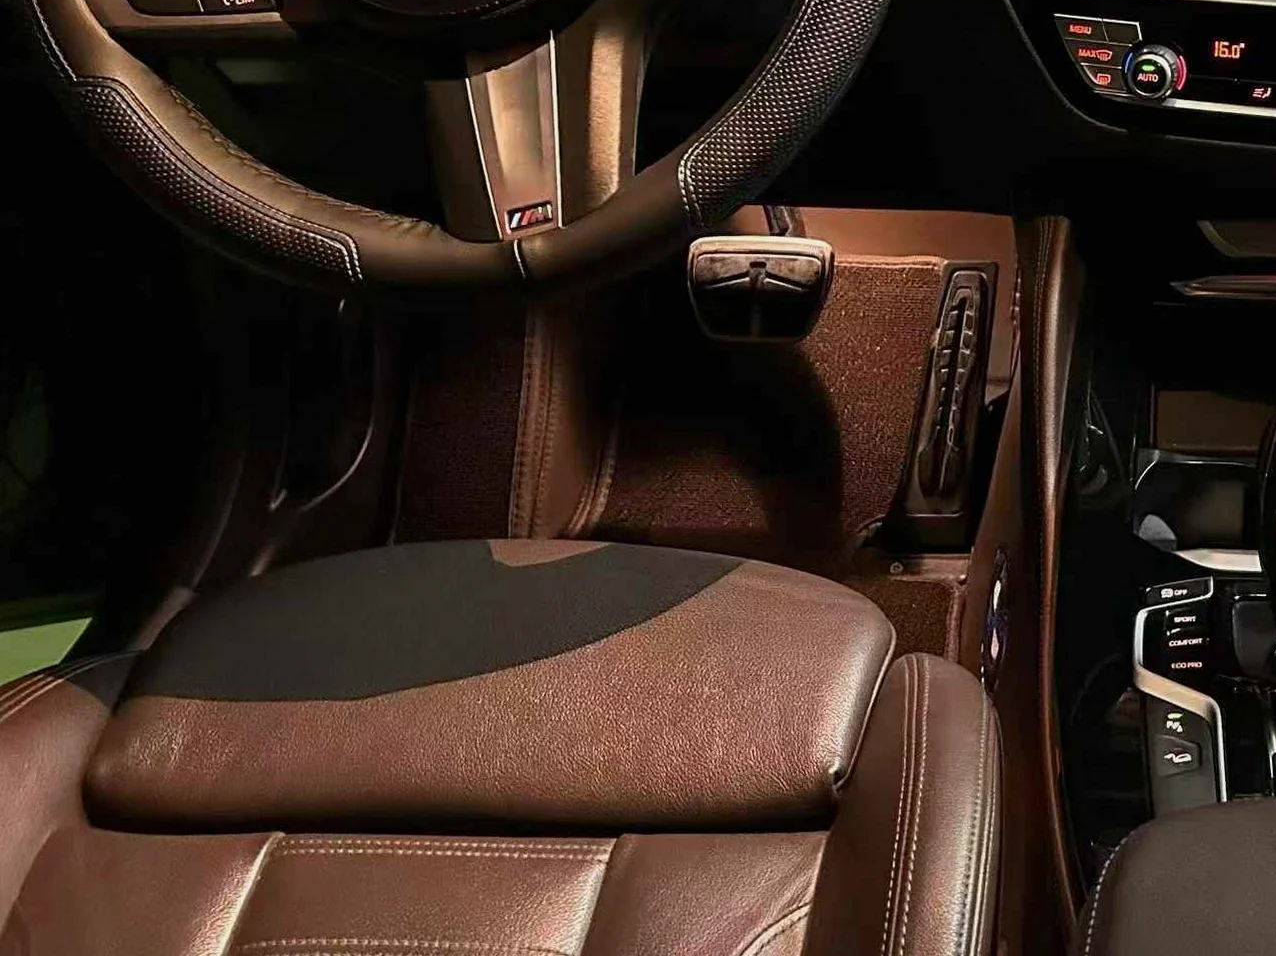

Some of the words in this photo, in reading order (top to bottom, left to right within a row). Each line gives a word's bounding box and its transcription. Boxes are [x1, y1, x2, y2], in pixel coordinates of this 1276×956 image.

[1068, 24, 1092, 35] MENU
[1078, 49, 1097, 58] MAX
[1137, 73, 1159, 83] AUTO
[1169, 637, 1203, 647] COMFORT
